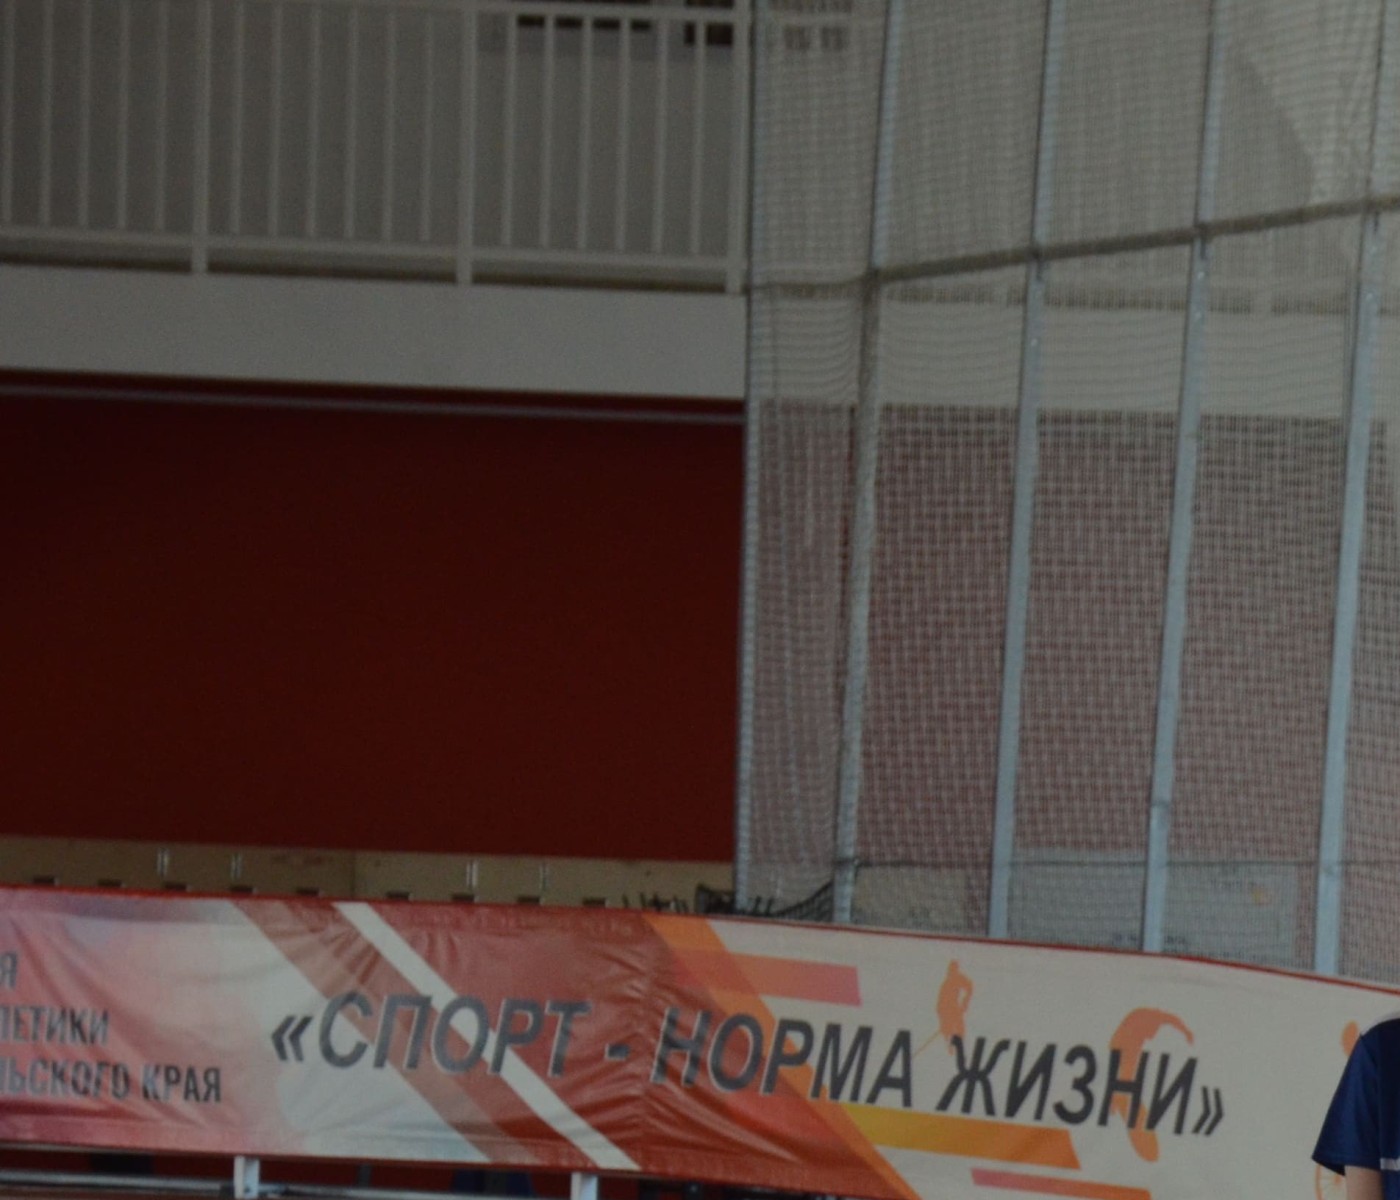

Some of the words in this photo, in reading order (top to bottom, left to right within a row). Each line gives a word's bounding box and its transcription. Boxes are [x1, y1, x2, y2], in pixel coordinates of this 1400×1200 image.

[142, 1063, 222, 1103] КРАЯ
[270, 991, 593, 1078] «СПОРТ
[651, 1006, 915, 1108] НОРМА
[935, 1034, 1226, 1138] ЖИЗНИ»
